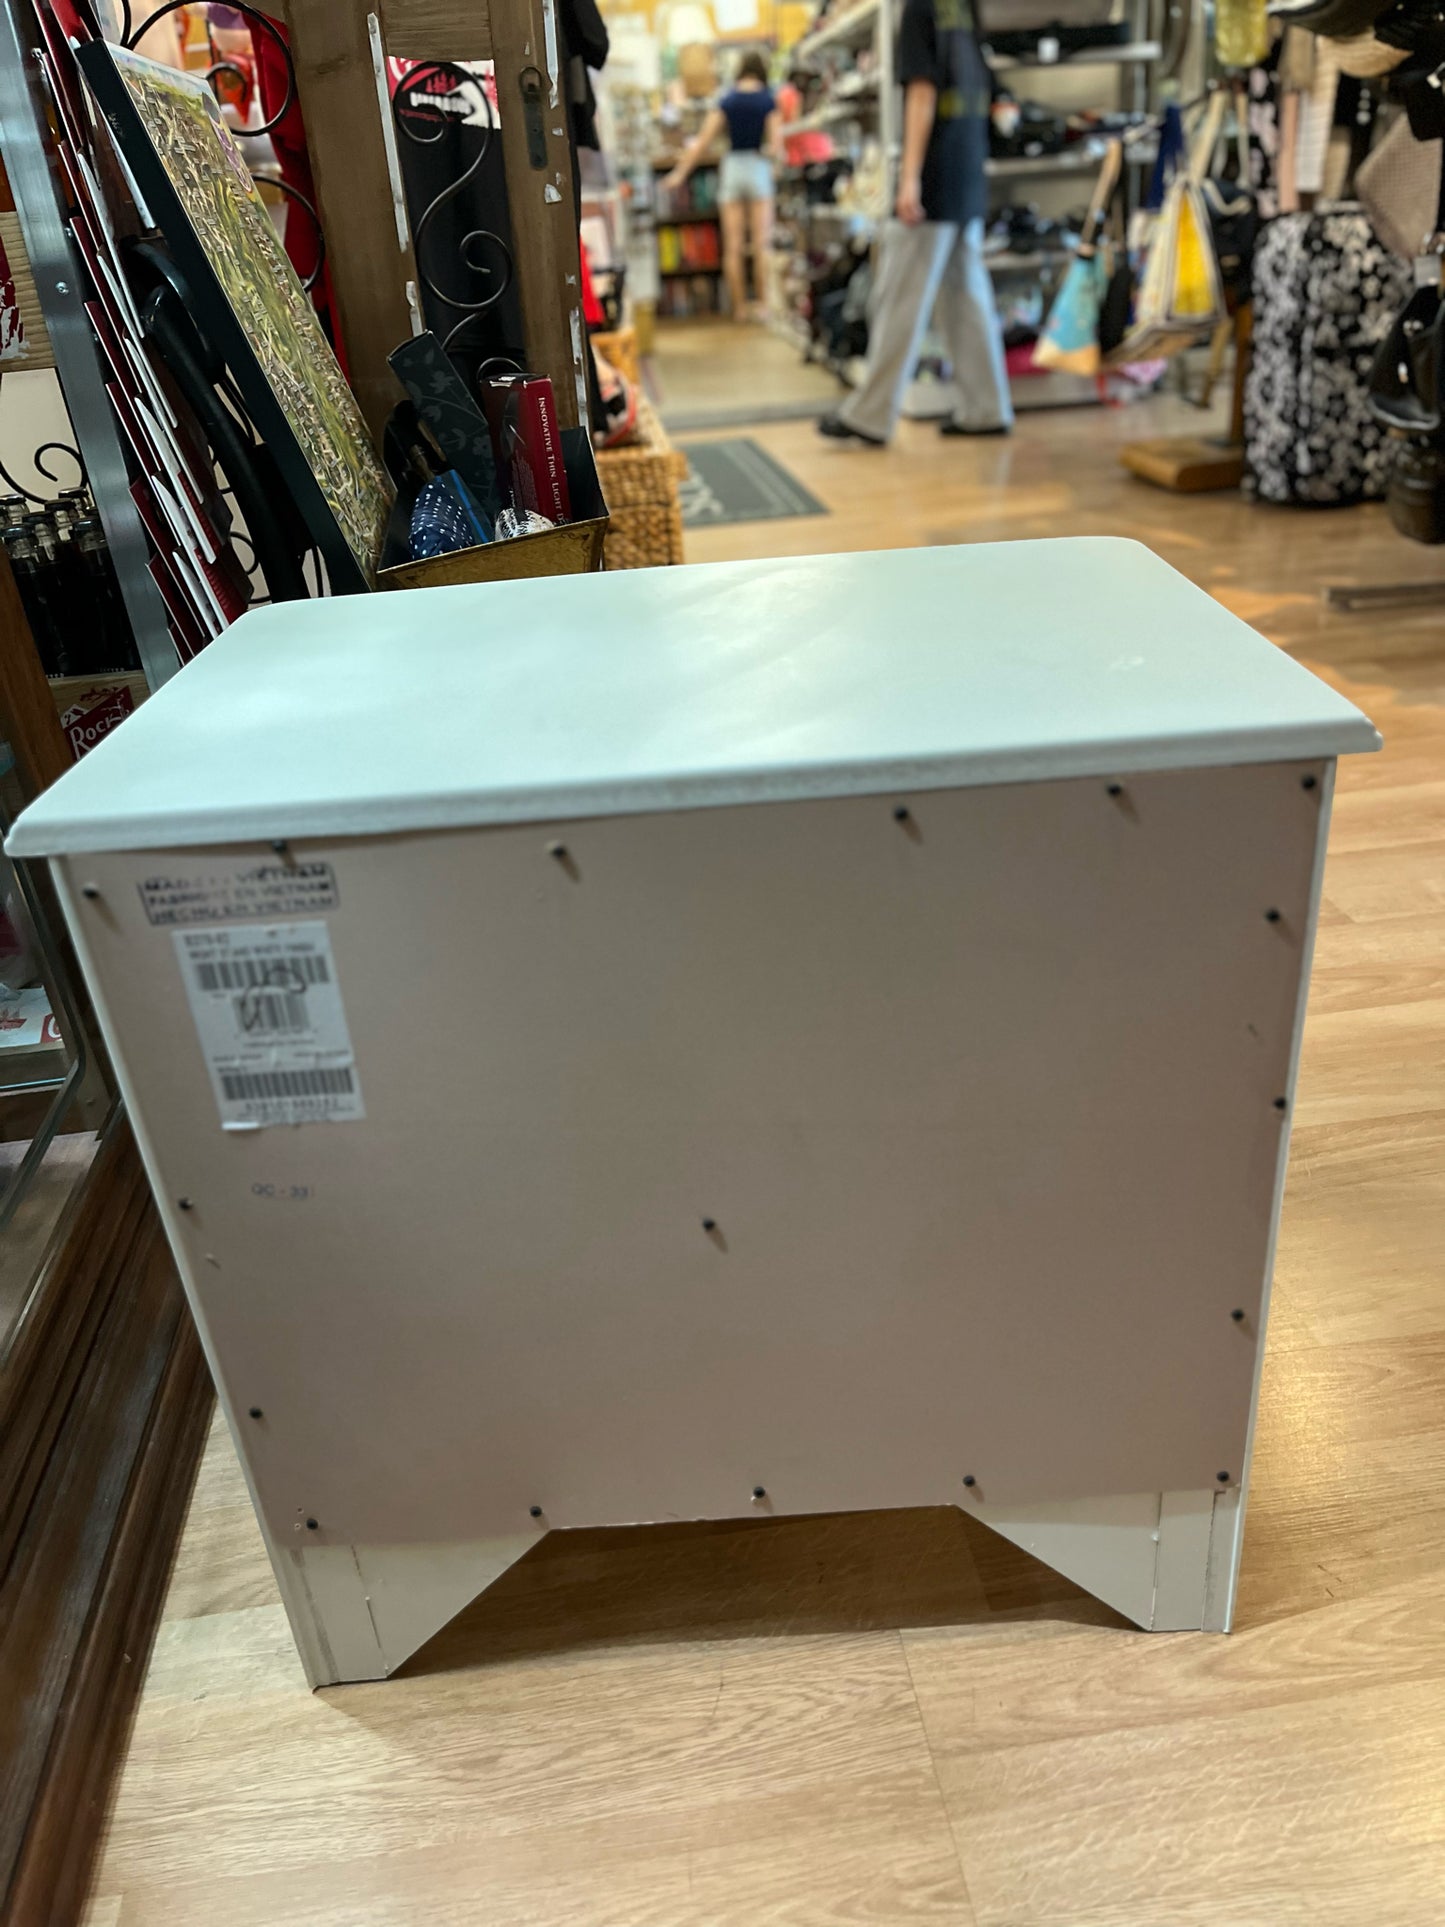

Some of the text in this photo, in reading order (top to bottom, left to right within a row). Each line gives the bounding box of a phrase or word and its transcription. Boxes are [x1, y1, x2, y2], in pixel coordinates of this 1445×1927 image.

[537, 396, 554, 454] INNOVATIVE
[547, 454, 557, 479] THIN
[551, 481, 563, 511] LIGHT
[261, 881, 330, 897] VIETNAM
[255, 896, 333, 914] VIETNAM
